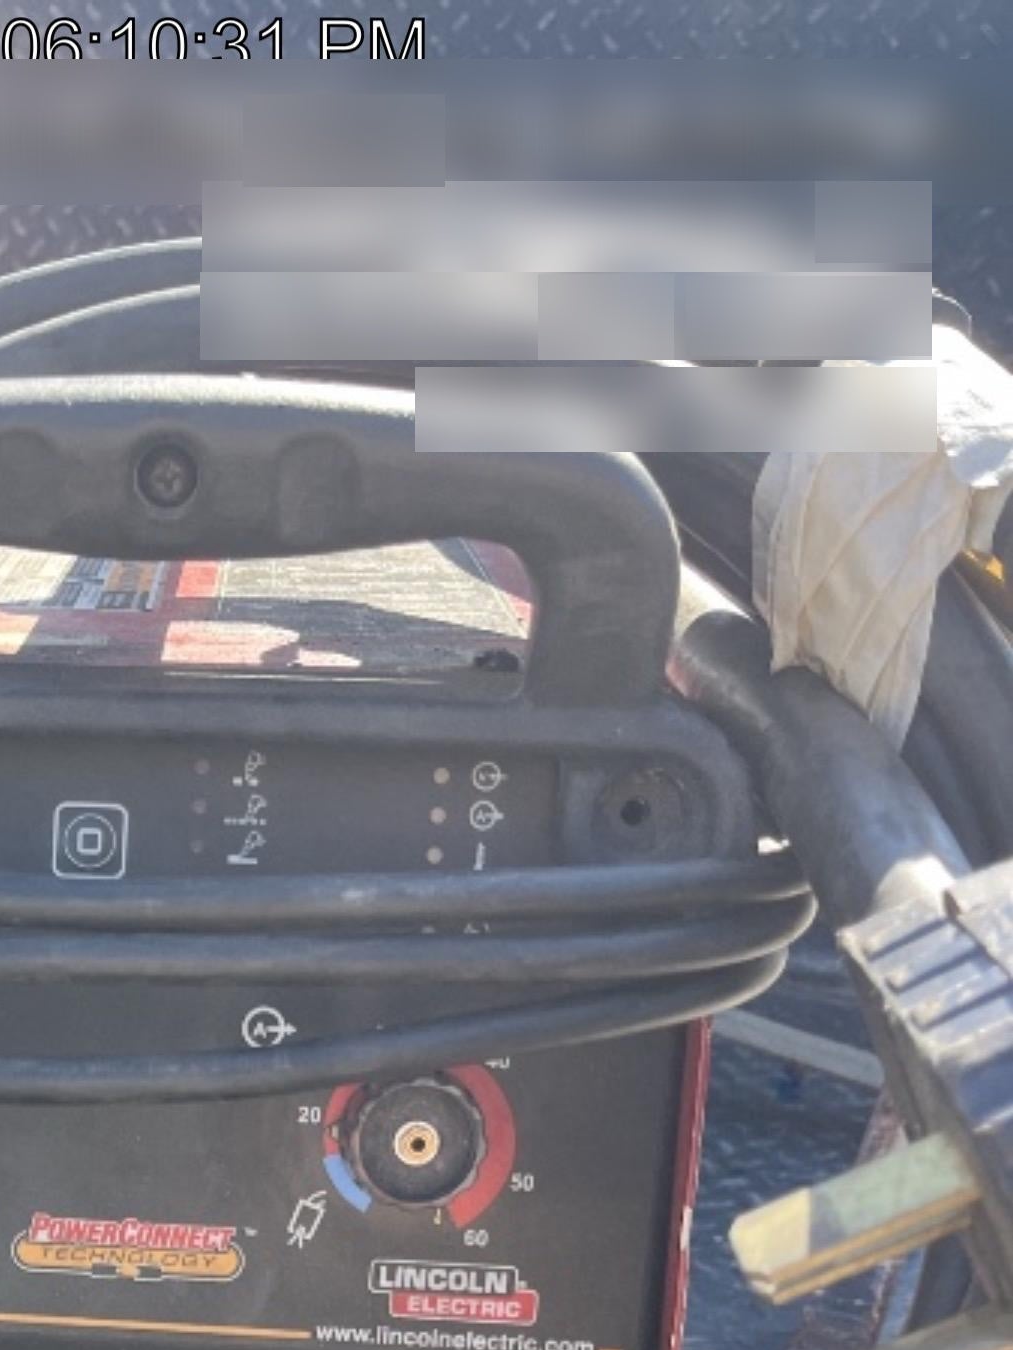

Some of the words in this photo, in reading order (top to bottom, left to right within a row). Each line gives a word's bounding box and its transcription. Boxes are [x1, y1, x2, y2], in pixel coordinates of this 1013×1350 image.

[298, 1106, 321, 1123] 20
[510, 1173, 534, 1192] 50
[464, 1229, 489, 1248] 60
[42, 1248, 217, 1267] TECHNOLOGY
[378, 1265, 509, 1294] LINCOLN
[406, 1296, 522, 1319] ELECTRIC
